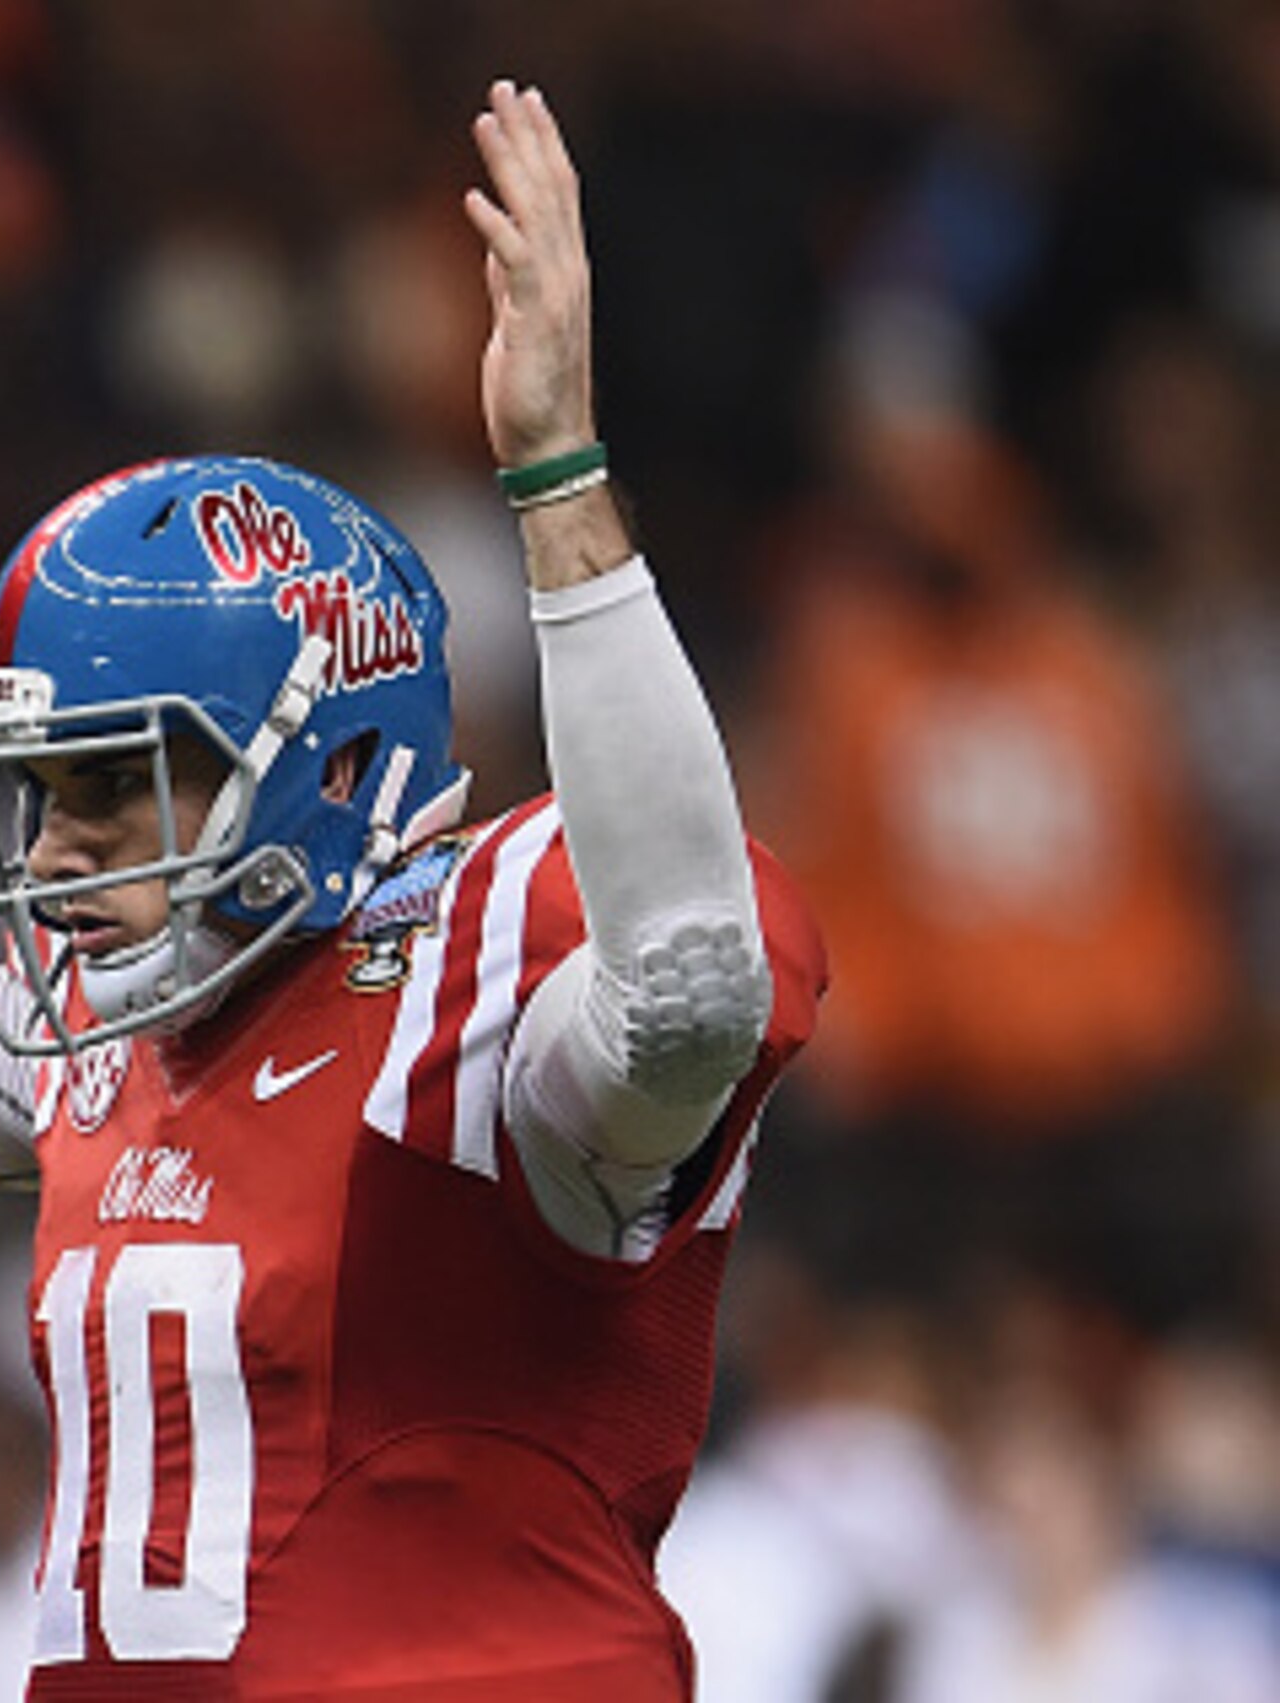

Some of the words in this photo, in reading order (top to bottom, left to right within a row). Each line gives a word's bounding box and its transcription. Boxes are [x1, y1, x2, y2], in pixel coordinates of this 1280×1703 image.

[193, 481, 312, 586] Ole
[273, 569, 424, 697] Miss
[25, 1243, 255, 1661] 10
